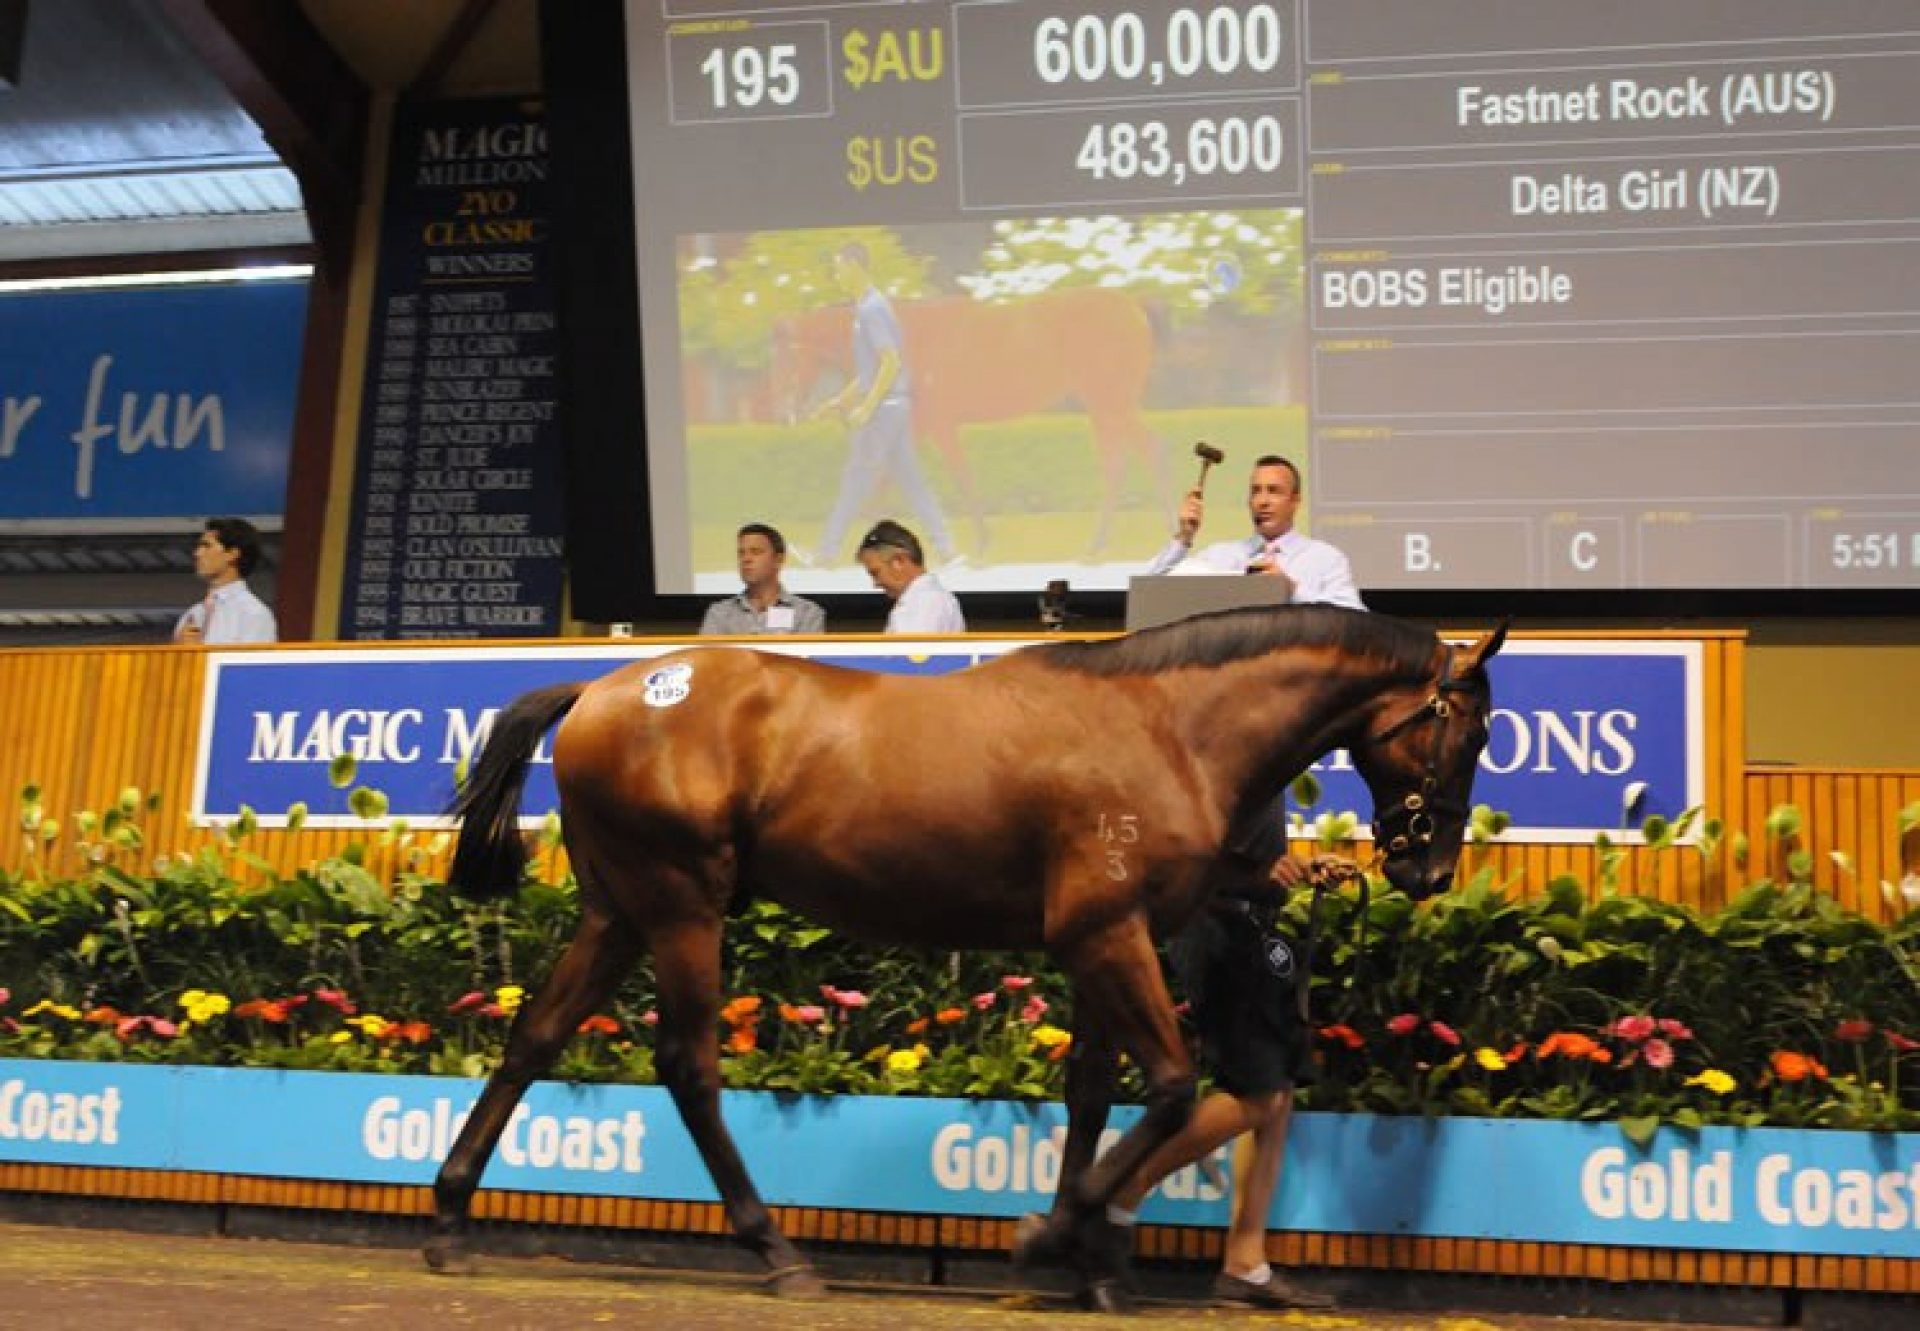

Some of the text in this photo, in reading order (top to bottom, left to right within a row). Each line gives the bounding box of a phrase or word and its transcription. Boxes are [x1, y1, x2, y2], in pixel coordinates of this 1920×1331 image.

[700, 27, 945, 108] 195 $AU
[1034, 4, 1281, 85] 600,000
[1457, 71, 1837, 126] Fastnet Rock (AUS)
[845, 135, 940, 190] $US
[1076, 115, 1284, 186] 483,600
[1511, 166, 1781, 217] Delta Girl (NZ)
[1322, 266, 1573, 315] BOBS Eligible
[70, 355, 226, 499] fun
[1404, 534, 1442, 572] B.
[1570, 531, 1598, 573] C
[1832, 534, 1900, 569] 5:51
[247, 708, 423, 764] MAGIC
[0, 1080, 122, 1147] Coast
[500, 1101, 647, 1174] Coast
[1581, 1146, 1733, 1222] Gold
